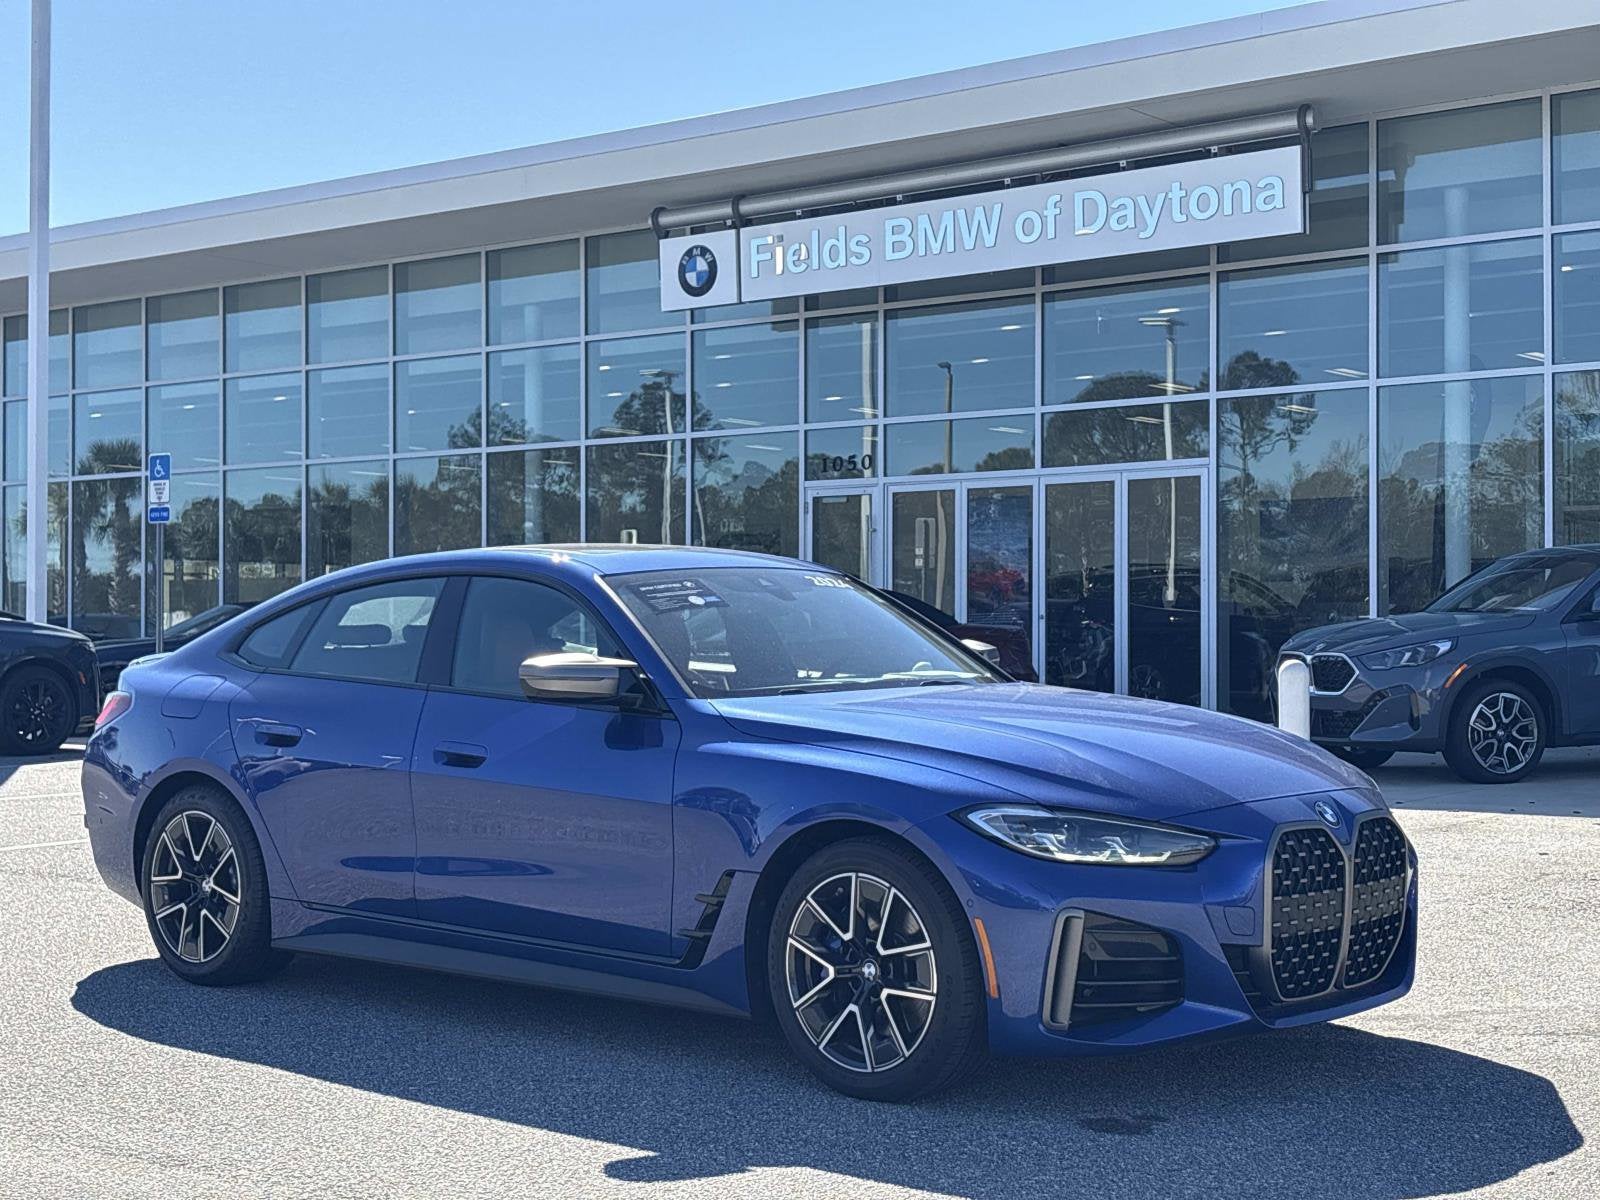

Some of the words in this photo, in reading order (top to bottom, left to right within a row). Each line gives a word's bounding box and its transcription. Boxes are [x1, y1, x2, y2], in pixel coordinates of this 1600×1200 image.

[750, 226, 872, 278] Fields
[884, 203, 1003, 261] BMW
[1014, 193, 1062, 244] of
[1073, 174, 1286, 239] Daytona
[681, 247, 714, 265] BMW
[821, 454, 872, 472] 1050
